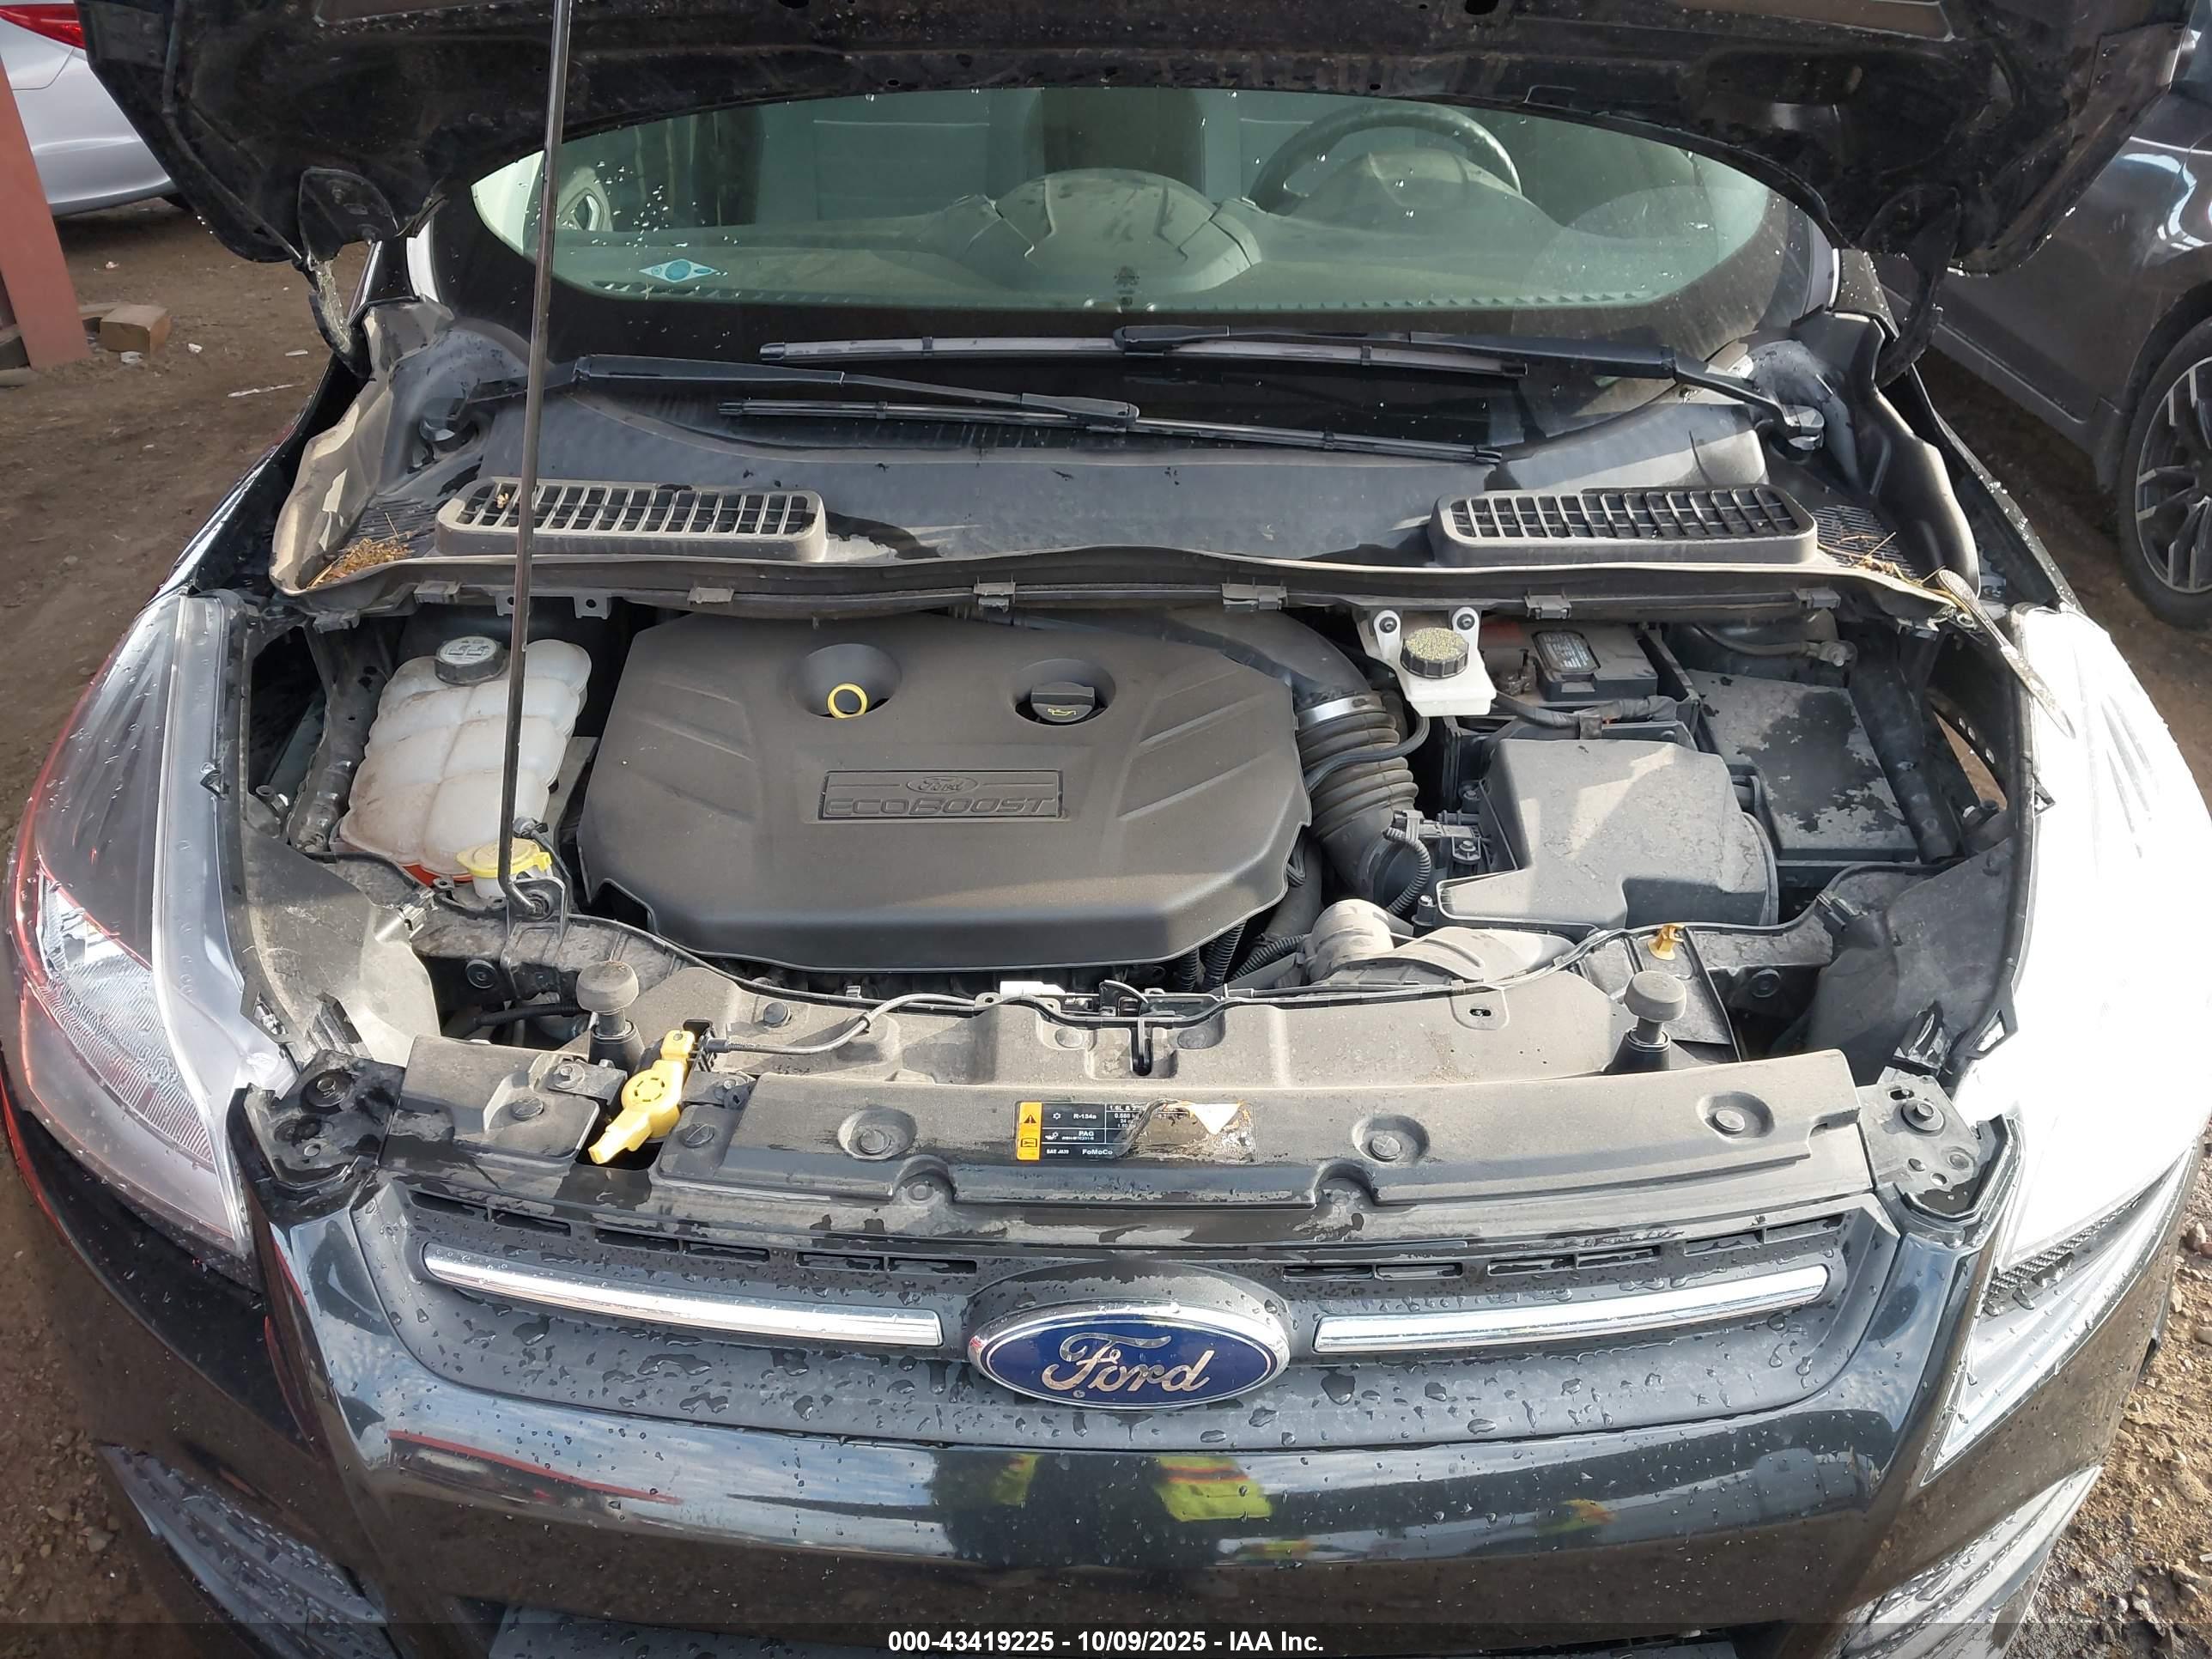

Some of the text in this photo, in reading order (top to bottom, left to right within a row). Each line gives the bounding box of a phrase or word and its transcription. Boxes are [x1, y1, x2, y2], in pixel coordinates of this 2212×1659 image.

[916, 775, 963, 792] Ford
[824, 797, 1054, 816] ECOBOOST
[1042, 1332, 1215, 1392] Ford
